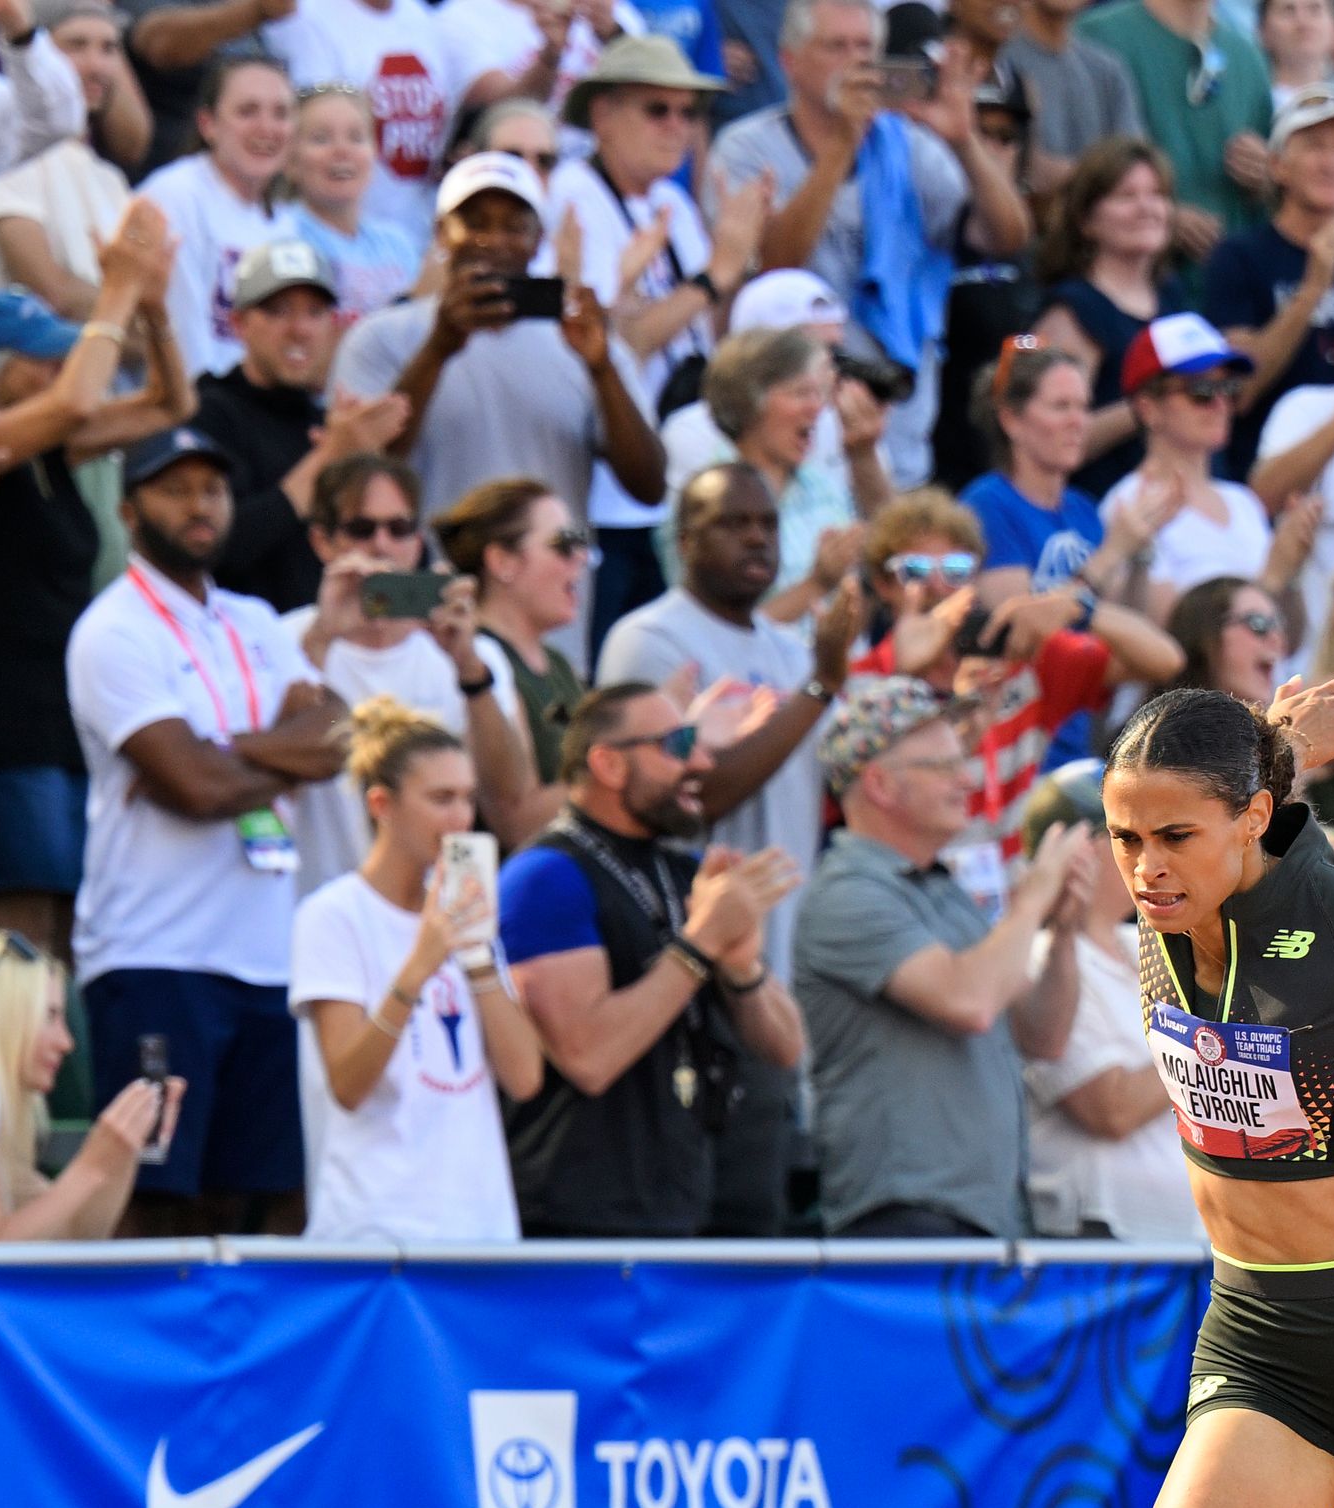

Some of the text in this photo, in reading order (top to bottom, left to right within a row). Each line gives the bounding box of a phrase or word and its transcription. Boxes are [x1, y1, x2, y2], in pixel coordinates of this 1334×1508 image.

[1234, 1030, 1283, 1044] U.S. OLYMPIC
[1235, 1041, 1282, 1055] TEAM TRIALS
[1162, 1052, 1278, 1100] MCLAUGHLIN
[1180, 1087, 1265, 1128] LEVRONE
